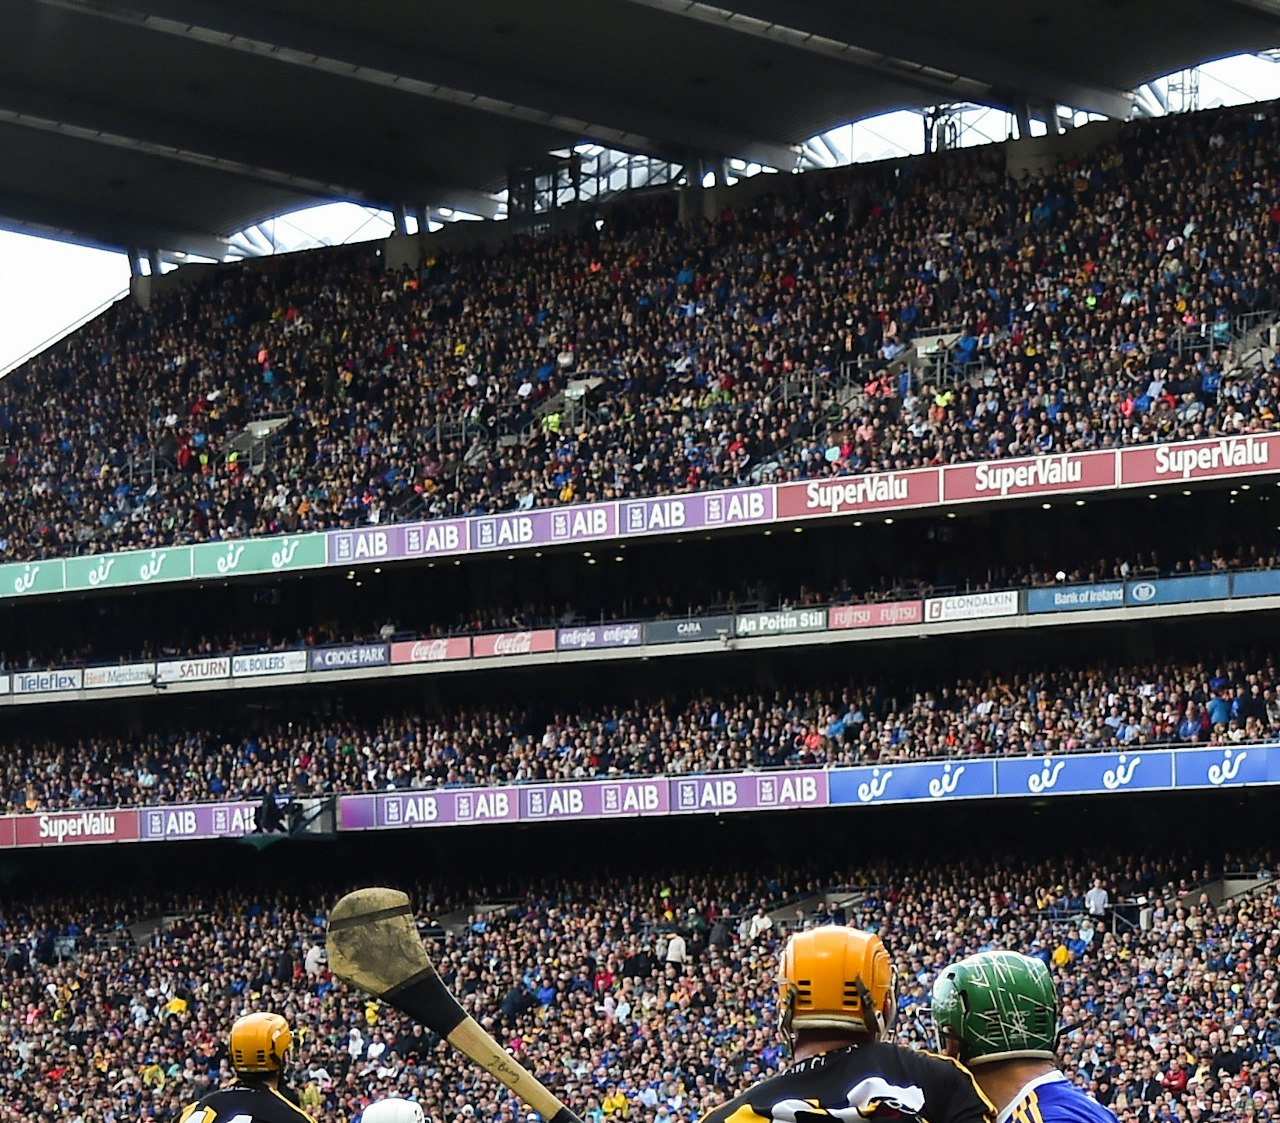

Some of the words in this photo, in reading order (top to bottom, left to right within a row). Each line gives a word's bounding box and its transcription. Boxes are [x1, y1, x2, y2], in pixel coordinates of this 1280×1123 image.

[1155, 438, 1268, 478] SuperValu
[975, 457, 1081, 496] SuperValu
[727, 493, 764, 521] AIB
[806, 476, 908, 513] SuperValu
[572, 509, 607, 536] AIB
[648, 501, 685, 529] AIB
[425, 525, 459, 551] AIB
[498, 517, 533, 544] AIB
[217, 544, 244, 573] eir
[272, 539, 299, 568] eir
[355, 532, 388, 558] AIB
[15, 565, 39, 593] eir
[89, 554, 115, 585] eir
[140, 551, 166, 580] eir
[944, 594, 1012, 610] CLONDALKIN
[1054, 591, 1078, 606] Bank
[1079, 590, 1089, 604] of
[1089, 587, 1124, 603] Ireland
[738, 614, 757, 632] An
[834, 609, 870, 627] FUJITSU
[880, 606, 917, 624] FUJITSU
[179, 657, 227, 679] SATURN
[325, 648, 357, 665] CROKE
[359, 646, 385, 663] PARK
[929, 764, 965, 797] eir
[1028, 758, 1065, 793] eir
[1103, 754, 1141, 790] eir
[1208, 749, 1247, 785] eir
[624, 785, 659, 811] AIB
[700, 780, 737, 807] AIB
[780, 776, 817, 802] AIB
[857, 768, 893, 802] eir
[404, 799, 438, 823] AIB
[475, 793, 509, 818] AIB
[549, 789, 584, 815] AIB
[39, 812, 115, 842] SuperValu
[166, 811, 197, 835] AIB
